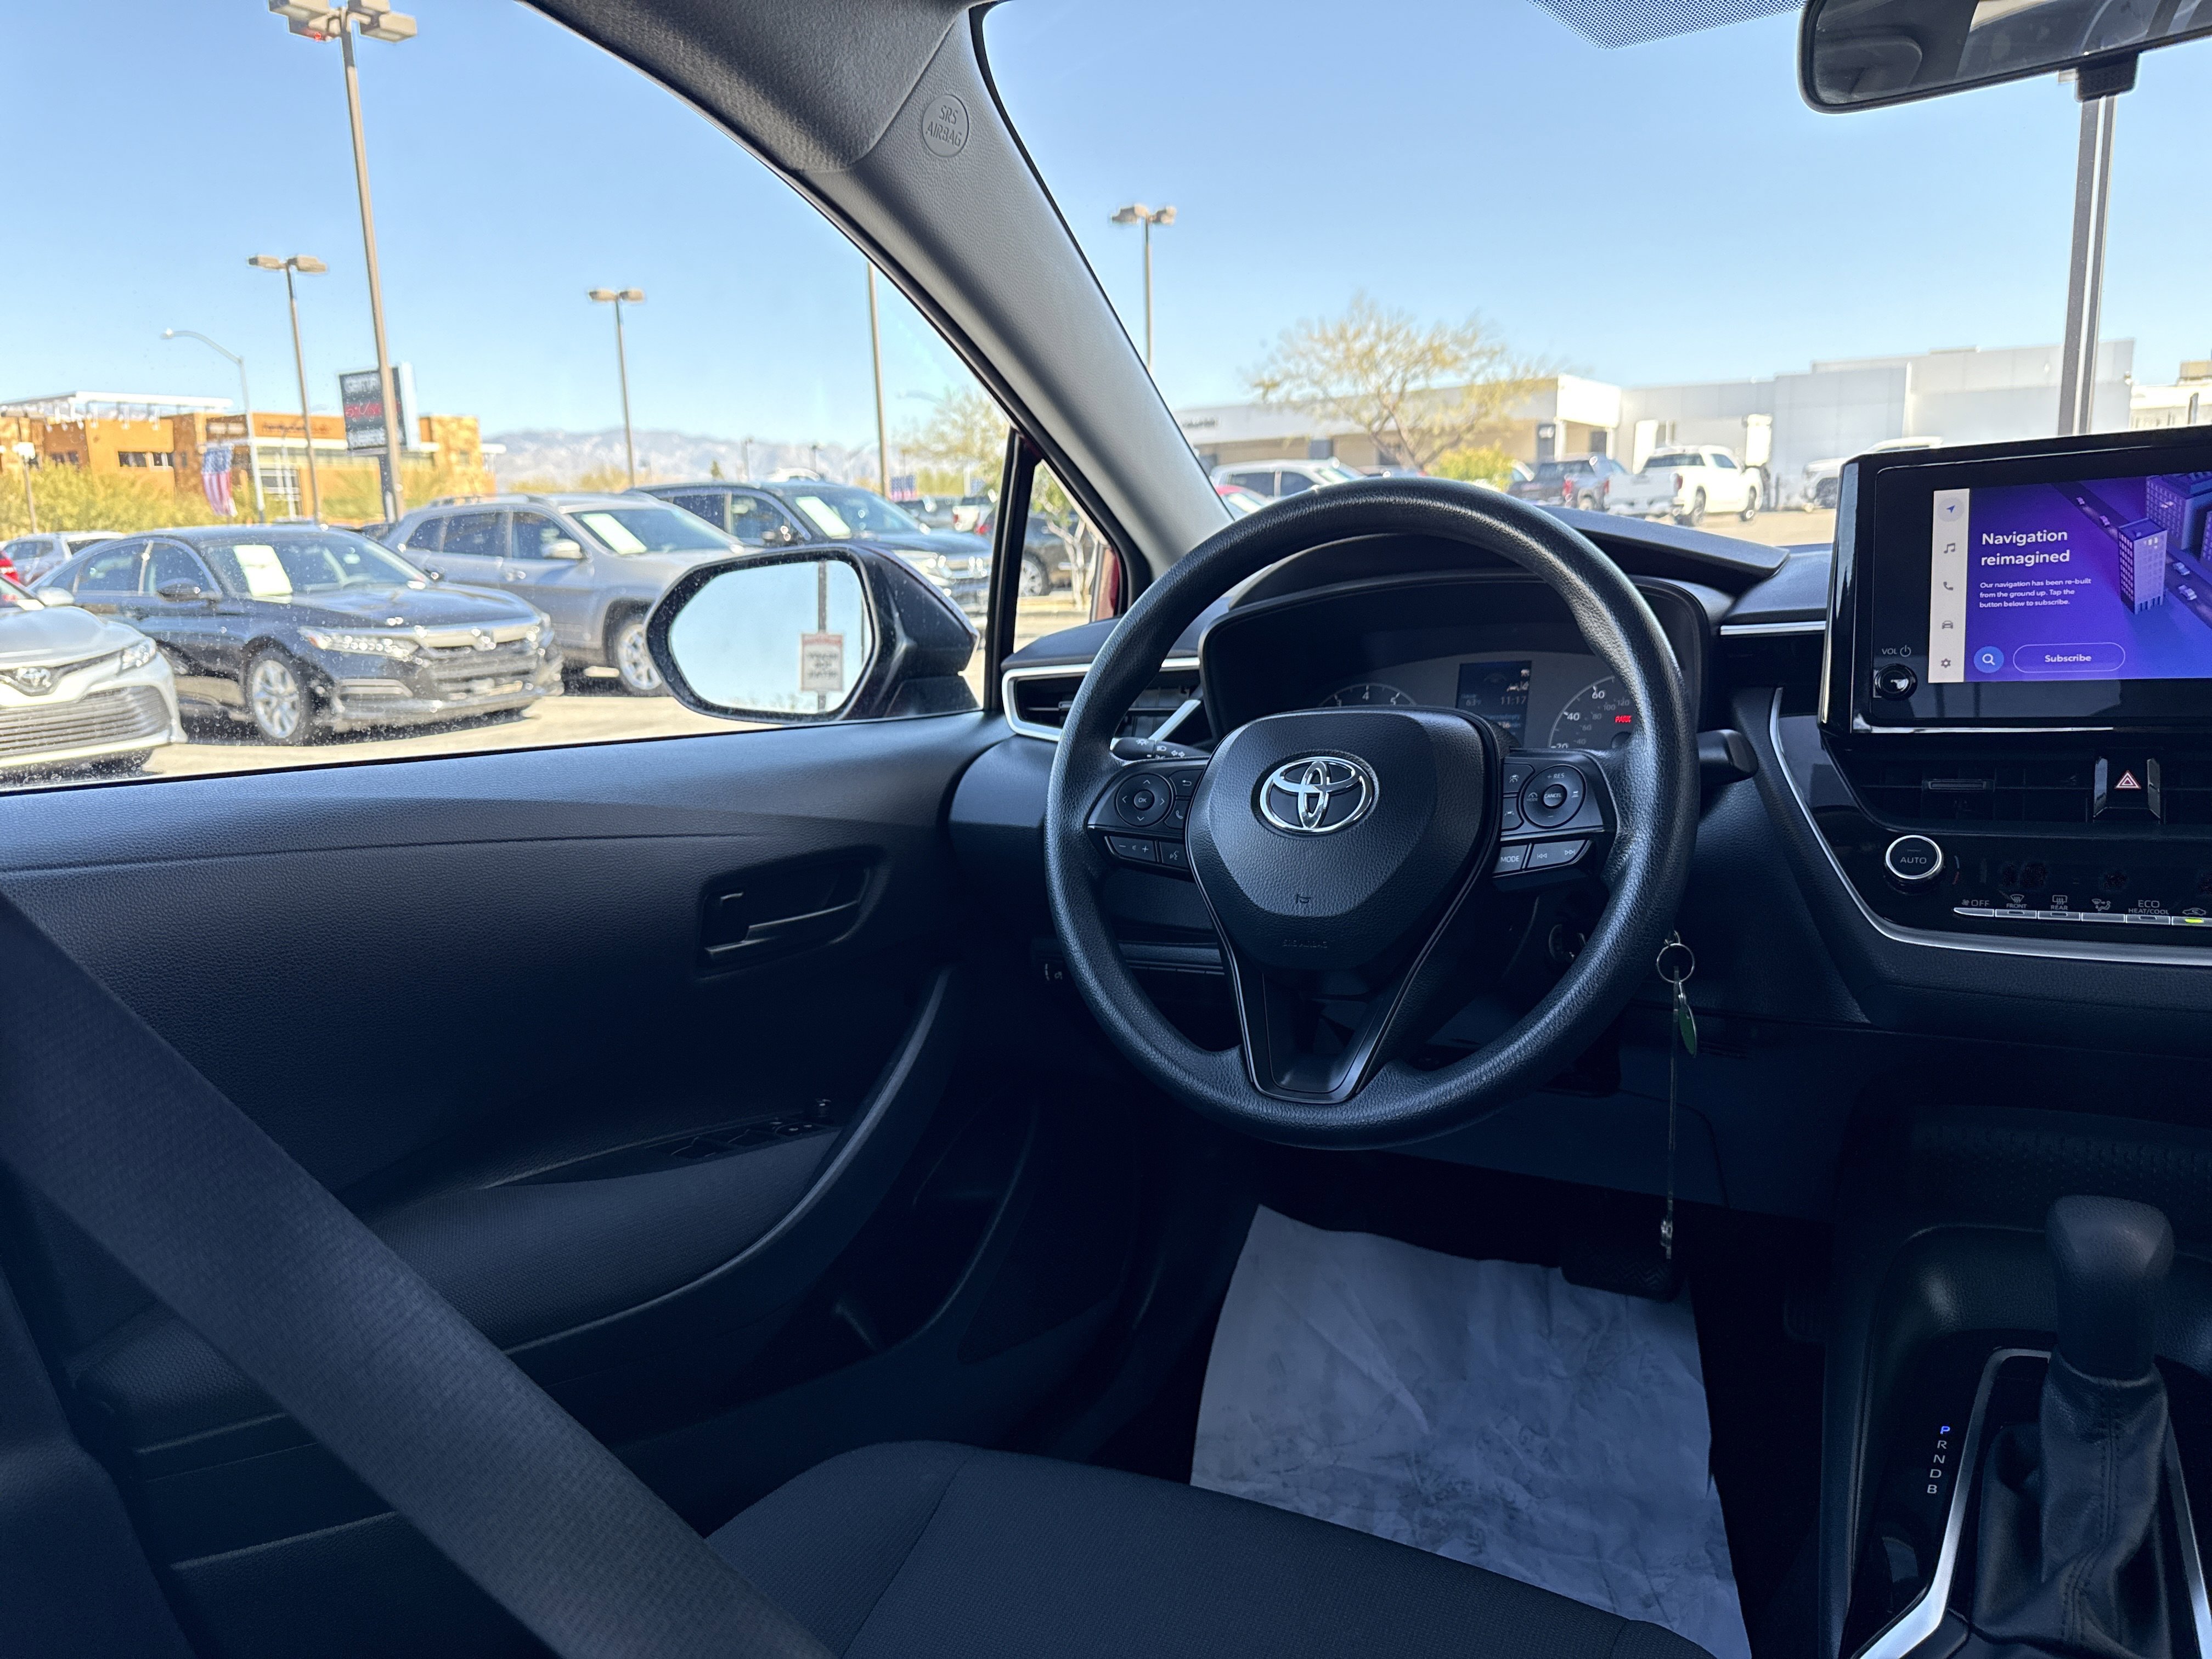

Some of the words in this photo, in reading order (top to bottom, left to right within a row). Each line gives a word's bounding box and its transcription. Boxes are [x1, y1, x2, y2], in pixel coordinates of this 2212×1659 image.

[939, 105, 958, 125] SRS
[926, 121, 962, 147] AIRBAG
[1982, 529, 2068, 546] Navigation
[1981, 549, 2070, 567] reimagined
[1994, 580, 2030, 589] navigation
[2009, 590, 2035, 599] ground
[2045, 654, 2092, 663] Subscribe
[1362, 692, 1369, 701] 4
[1592, 690, 1605, 699] 60
[1501, 696, 1526, 705] 11:17
[1567, 712, 1580, 721] 40
[2138, 899, 2160, 908] ECO
[1940, 1426, 1950, 1435] P
[1937, 1440, 1947, 1449] R
[1933, 1454, 1946, 1464] N
[1929, 1469, 1942, 1478] D
[1927, 1484, 1938, 1494] B
